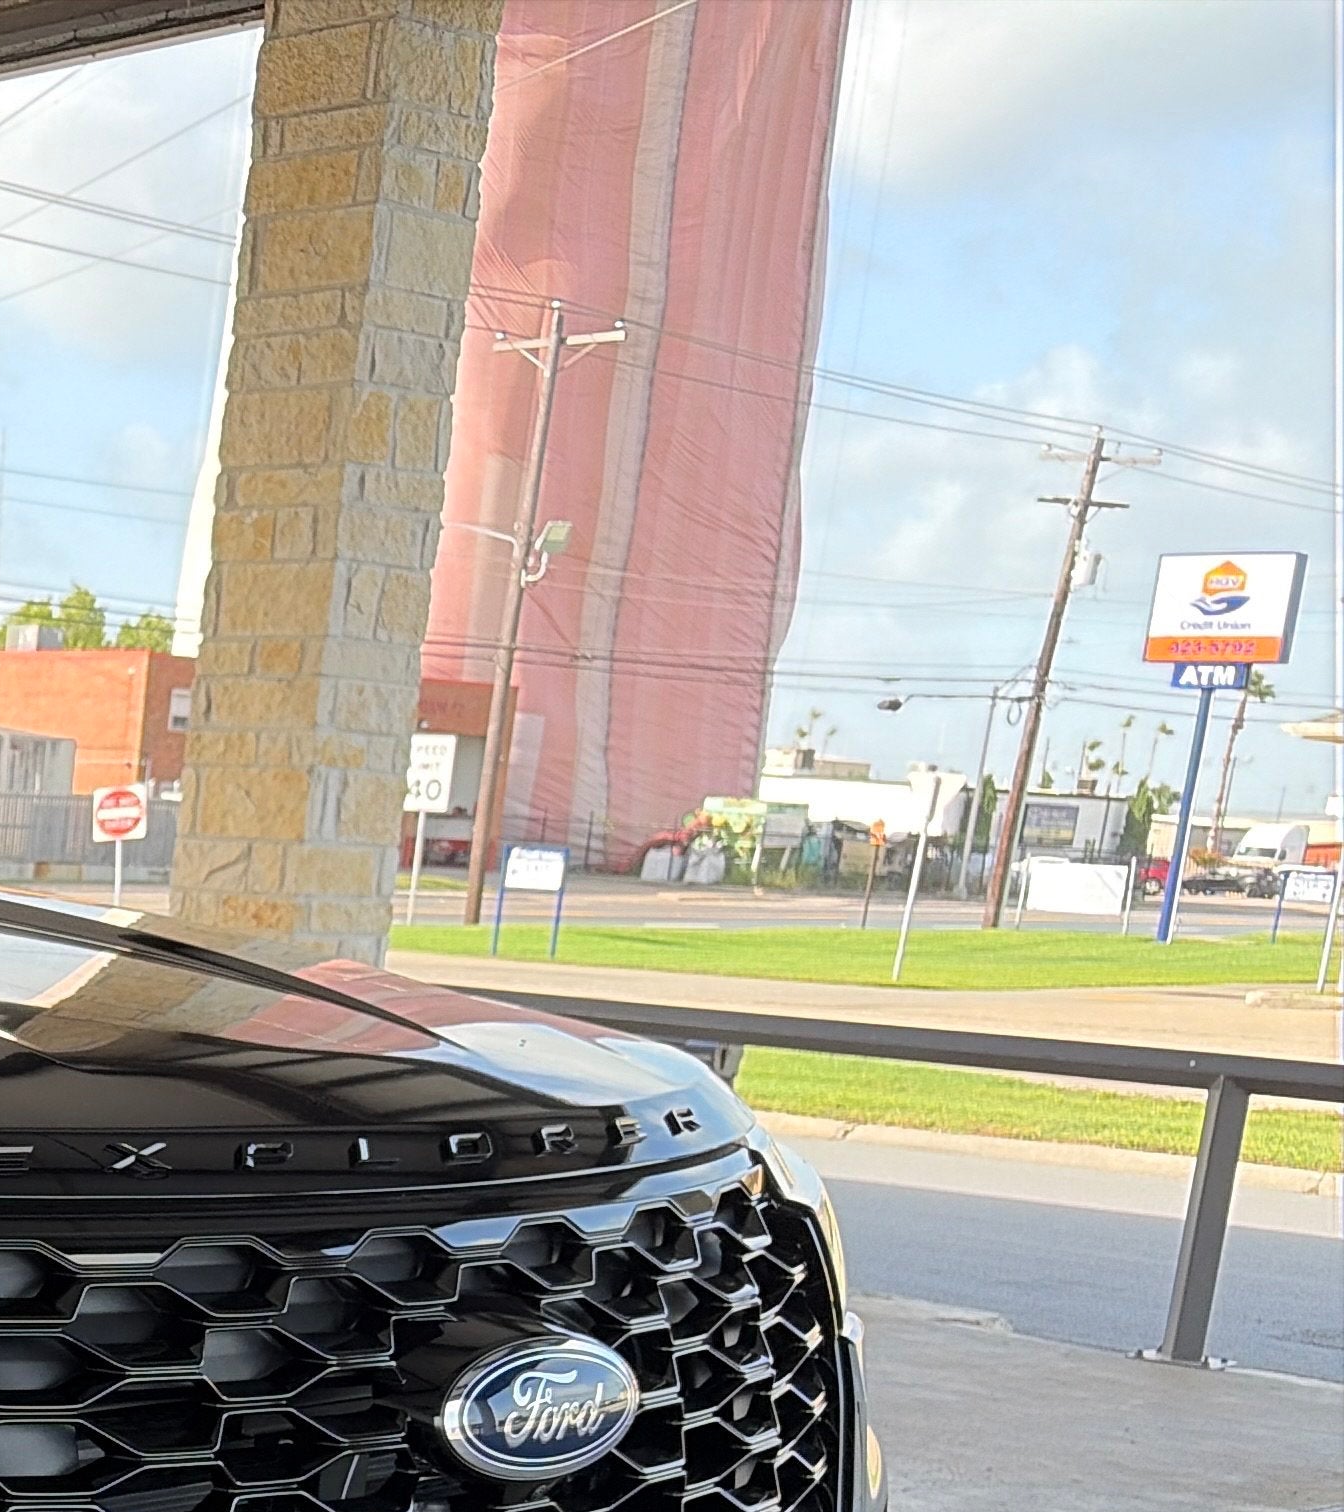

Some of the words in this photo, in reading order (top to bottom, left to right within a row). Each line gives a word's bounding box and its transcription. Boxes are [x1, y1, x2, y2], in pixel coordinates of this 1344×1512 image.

[1179, 620, 1214, 631] Credit
[1217, 620, 1252, 631] Union
[1178, 665, 1236, 686] ATM
[409, 779, 442, 801] 40
[503, 1369, 605, 1447] Ford
